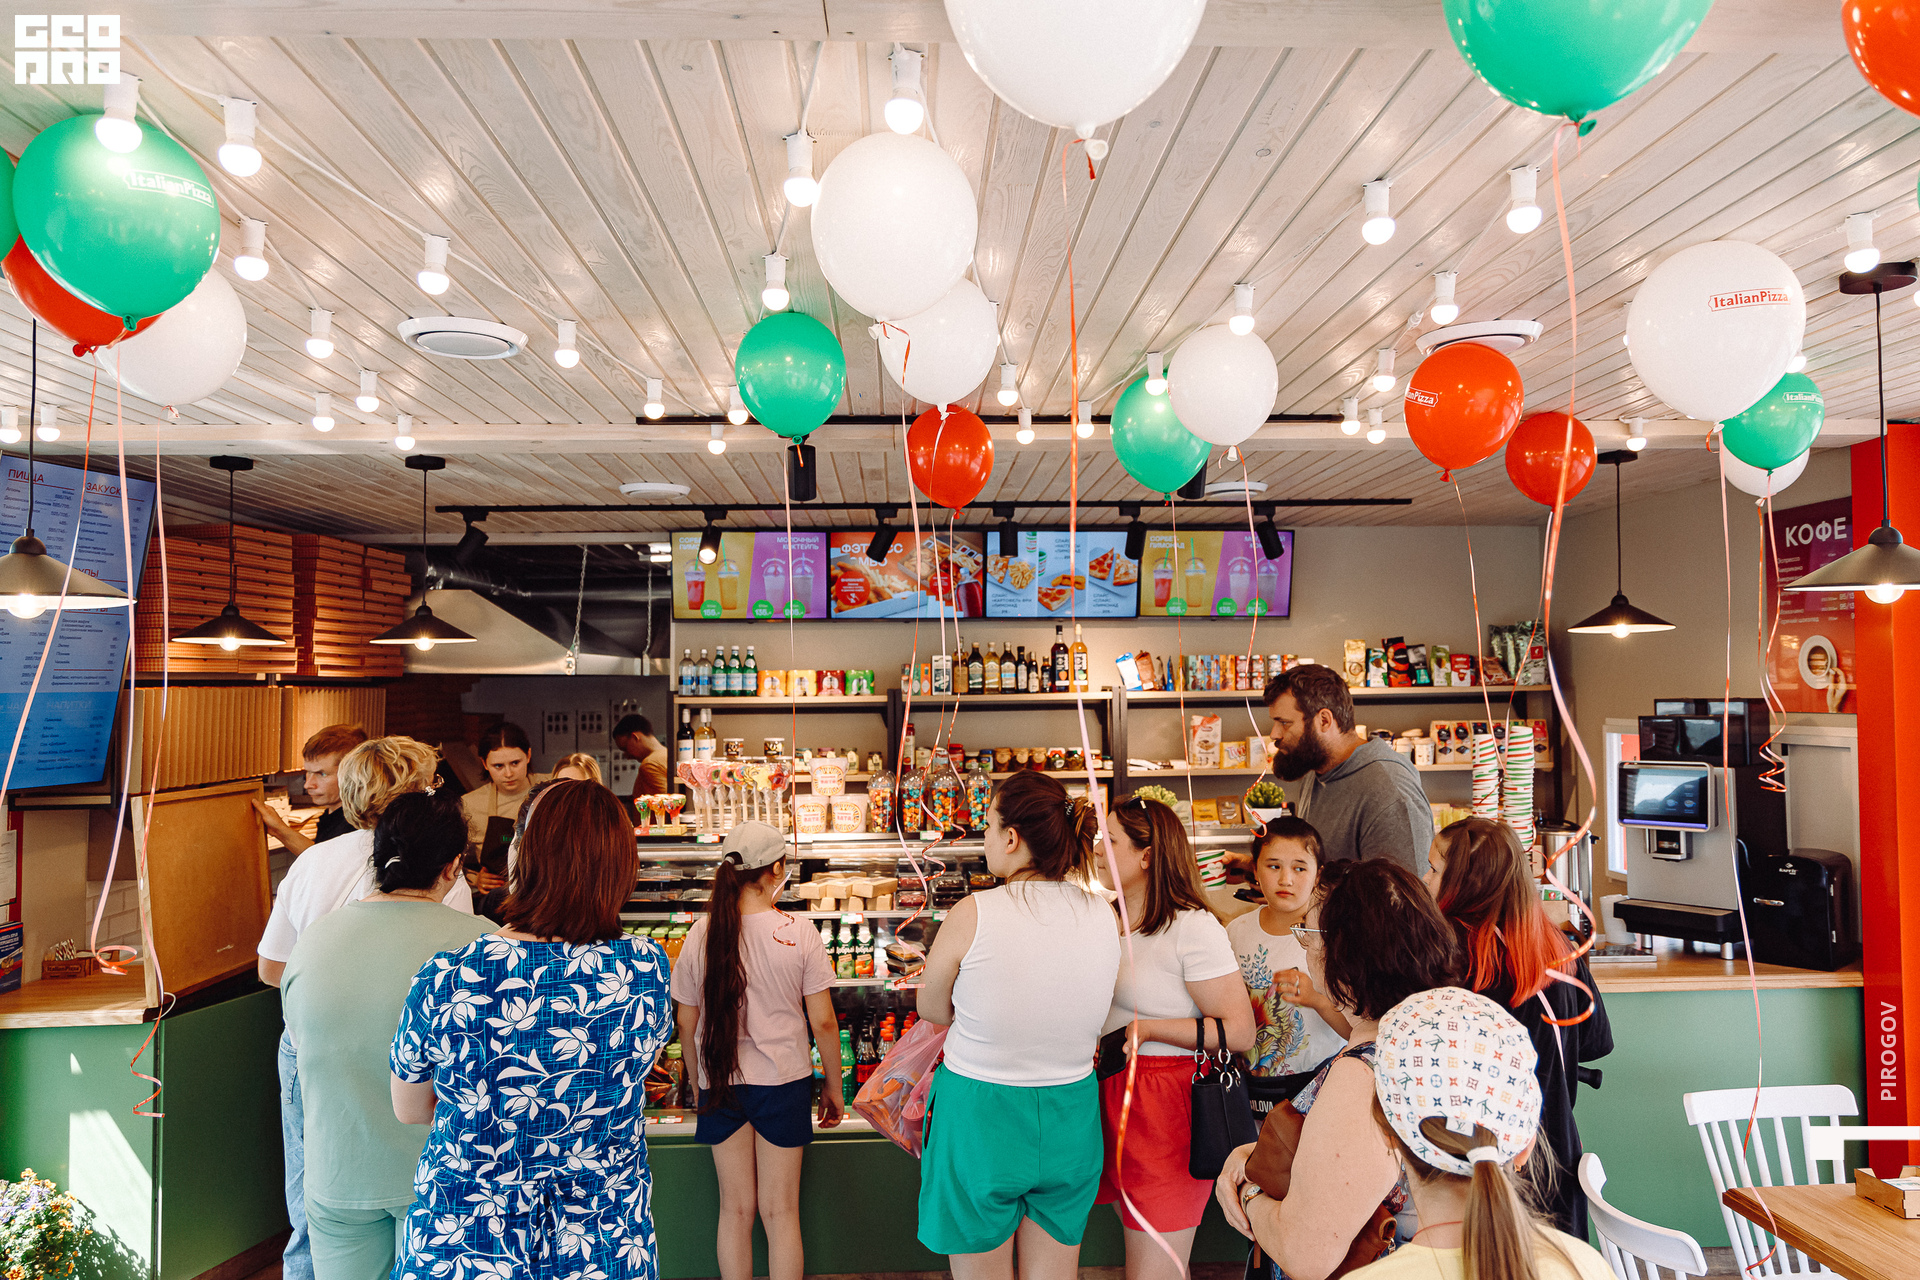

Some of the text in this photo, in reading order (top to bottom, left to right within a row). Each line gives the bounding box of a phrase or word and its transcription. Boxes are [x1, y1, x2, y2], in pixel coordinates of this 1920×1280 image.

[130, 172, 212, 204] ItalianPizza
[1713, 290, 1789, 309] ItalianPizza
[86, 482, 128, 496] ЗАКУСК
[1785, 517, 1847, 547] КОФЕ
[841, 542, 903, 554] ФЭТСС
